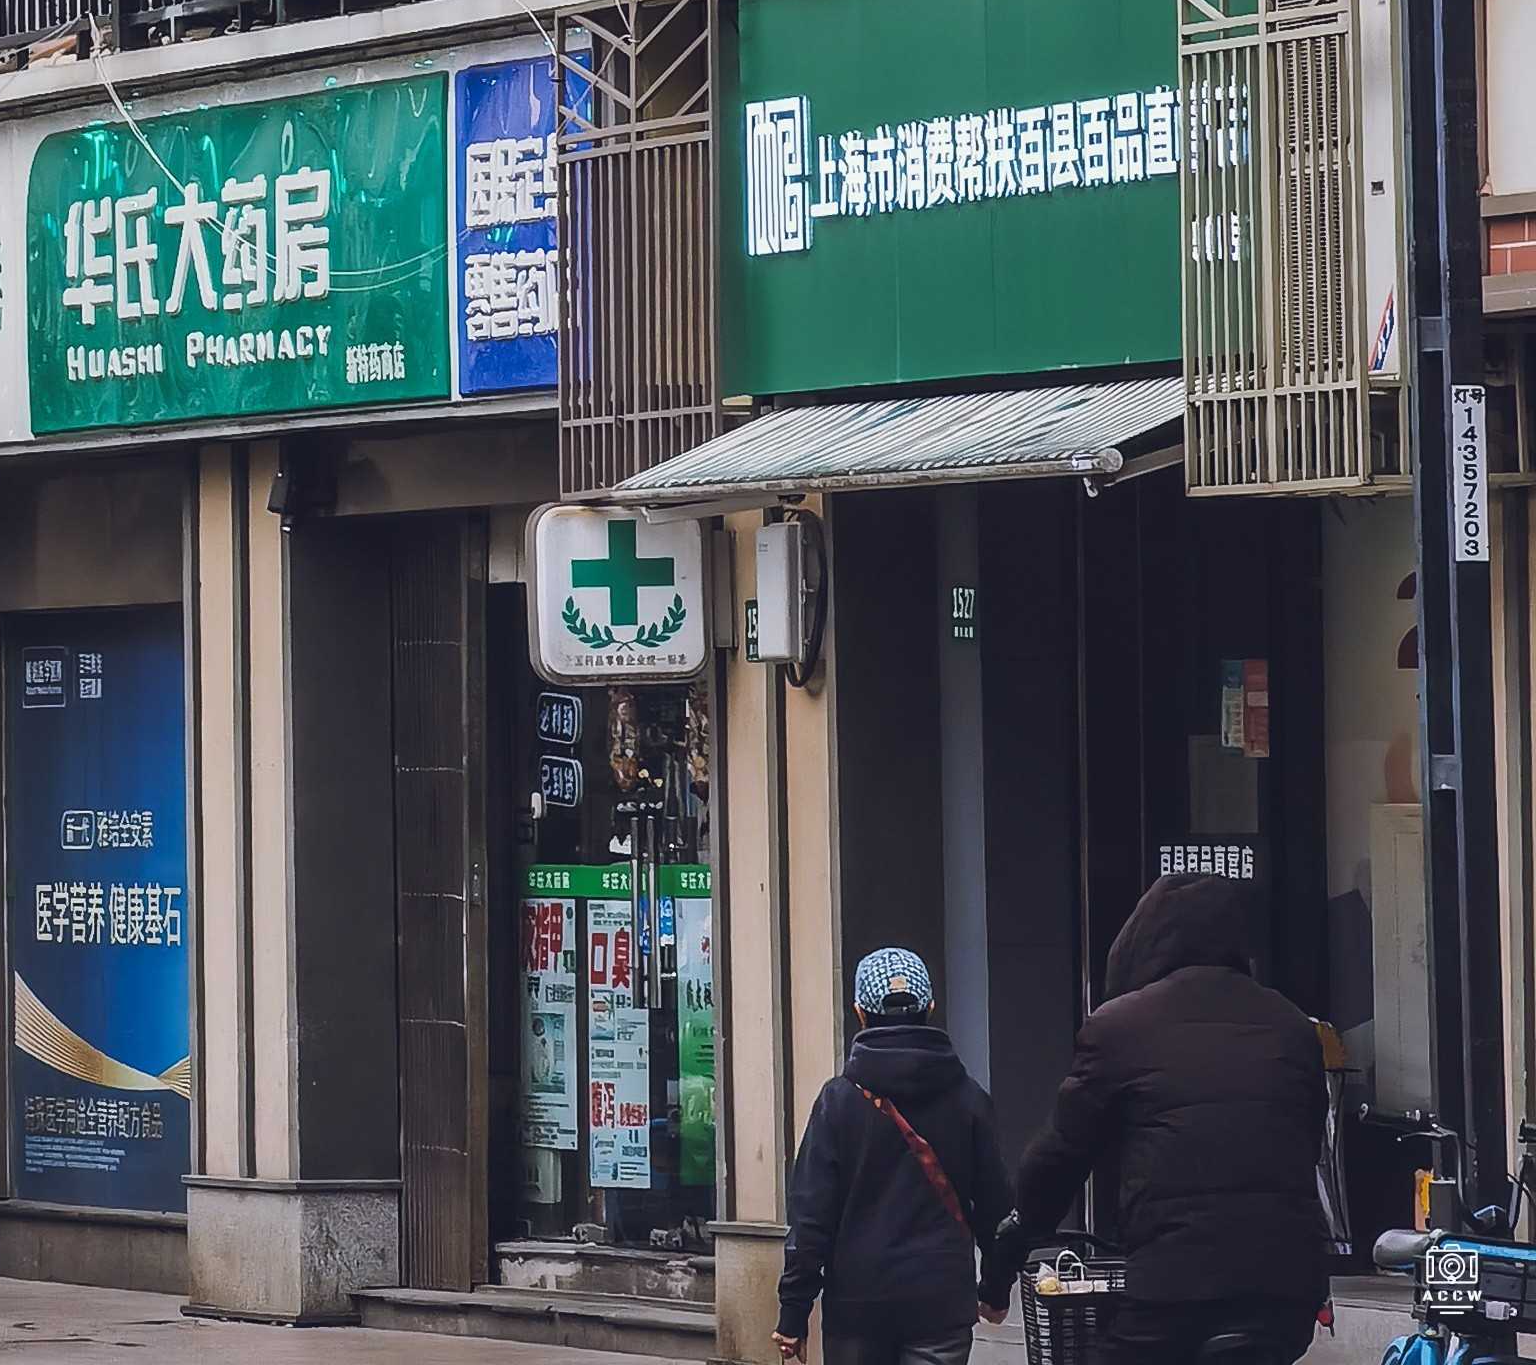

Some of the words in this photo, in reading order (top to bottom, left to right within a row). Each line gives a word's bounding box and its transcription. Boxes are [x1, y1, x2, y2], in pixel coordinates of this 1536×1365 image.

[62, 165, 333, 326] 华氏大药房
[66, 341, 165, 382] HUASHI
[185, 324, 333, 370] PHARMACY
[1454, 388, 1487, 404] 灯号
[1461, 407, 1480, 556] 14357203
[953, 587, 975, 619] 1527
[565, 653, 688, 667] 国药品零售企业统一标志
[35, 882, 104, 944] 医学营养
[109, 882, 182, 947] 健康基石
[590, 928, 632, 989] 口臭
